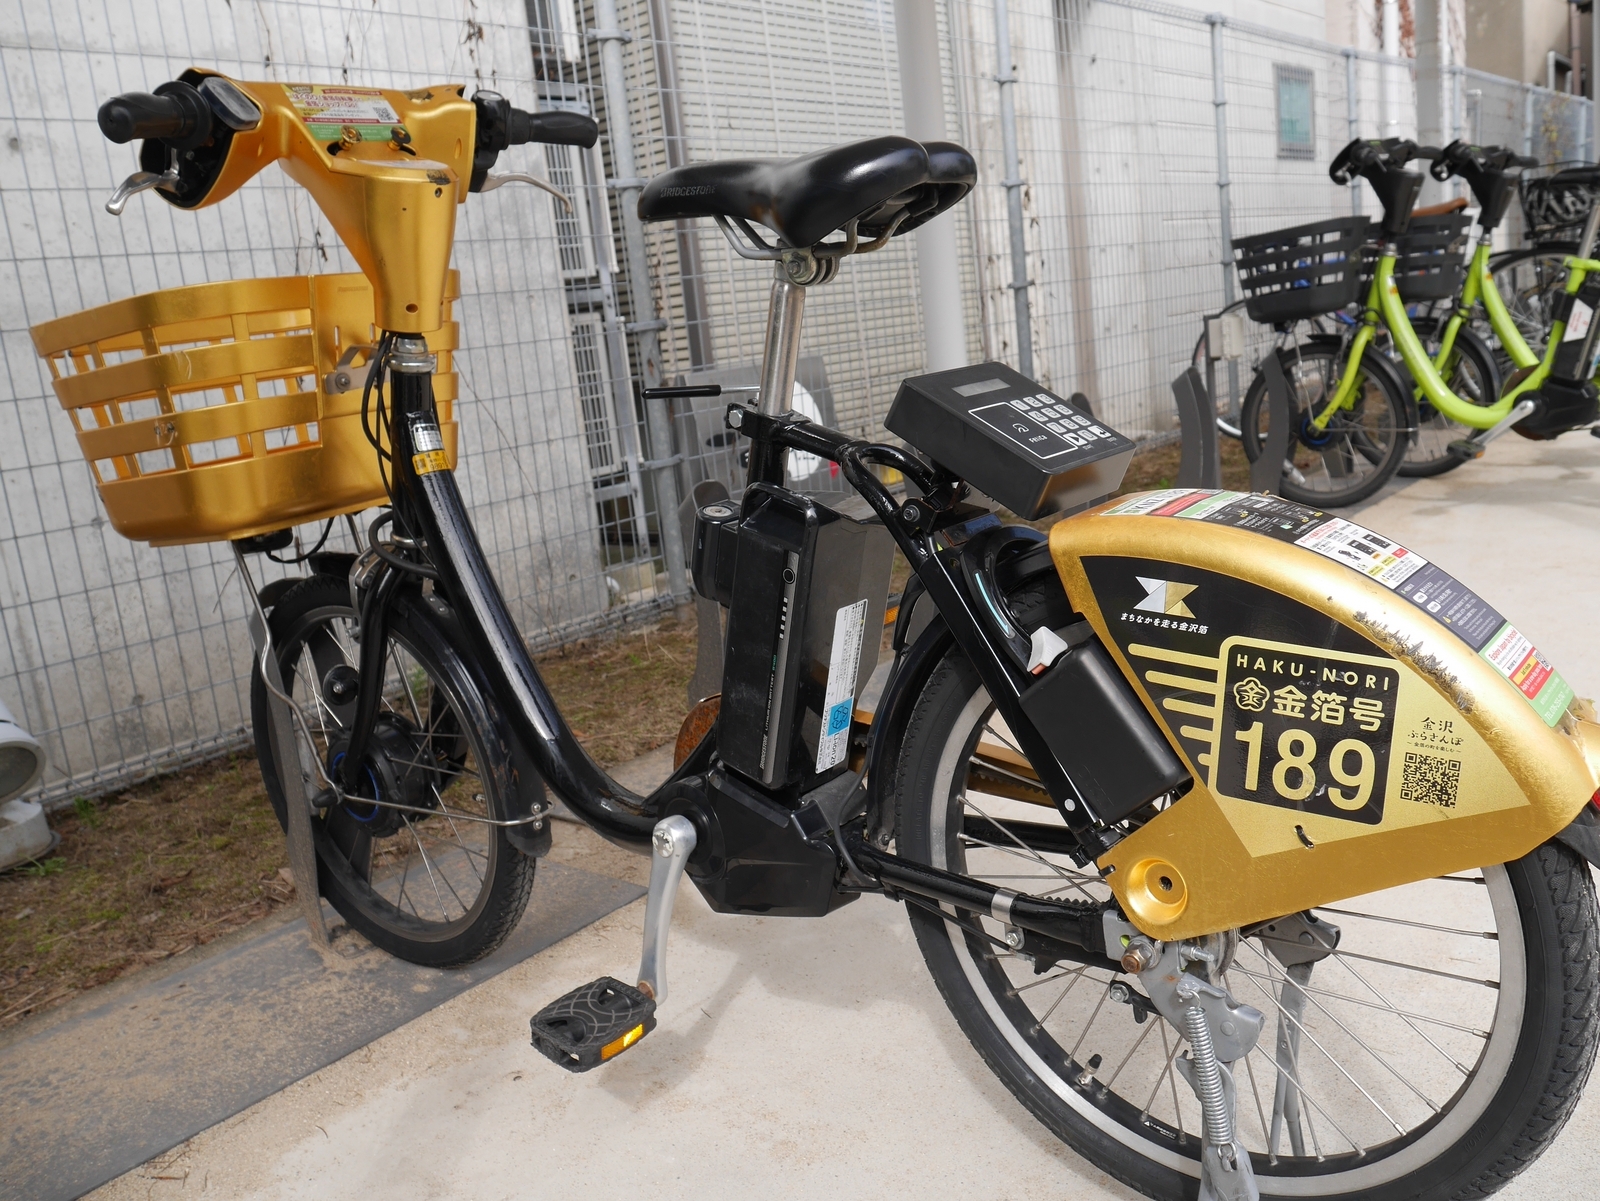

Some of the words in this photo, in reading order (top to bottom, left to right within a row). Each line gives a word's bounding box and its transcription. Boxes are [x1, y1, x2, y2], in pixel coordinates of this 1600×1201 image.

[660, 185, 717, 198] BRIDGESTONE
[1120, 612, 1209, 635] まちなかを走る金沢箔
[1236, 653, 1389, 691] HAKU-NORI
[1271, 684, 1386, 732] 金箔号
[1421, 716, 1454, 734] 金沢
[1407, 729, 1464, 746] ぶらさんぽ
[1235, 721, 1376, 811] 189
